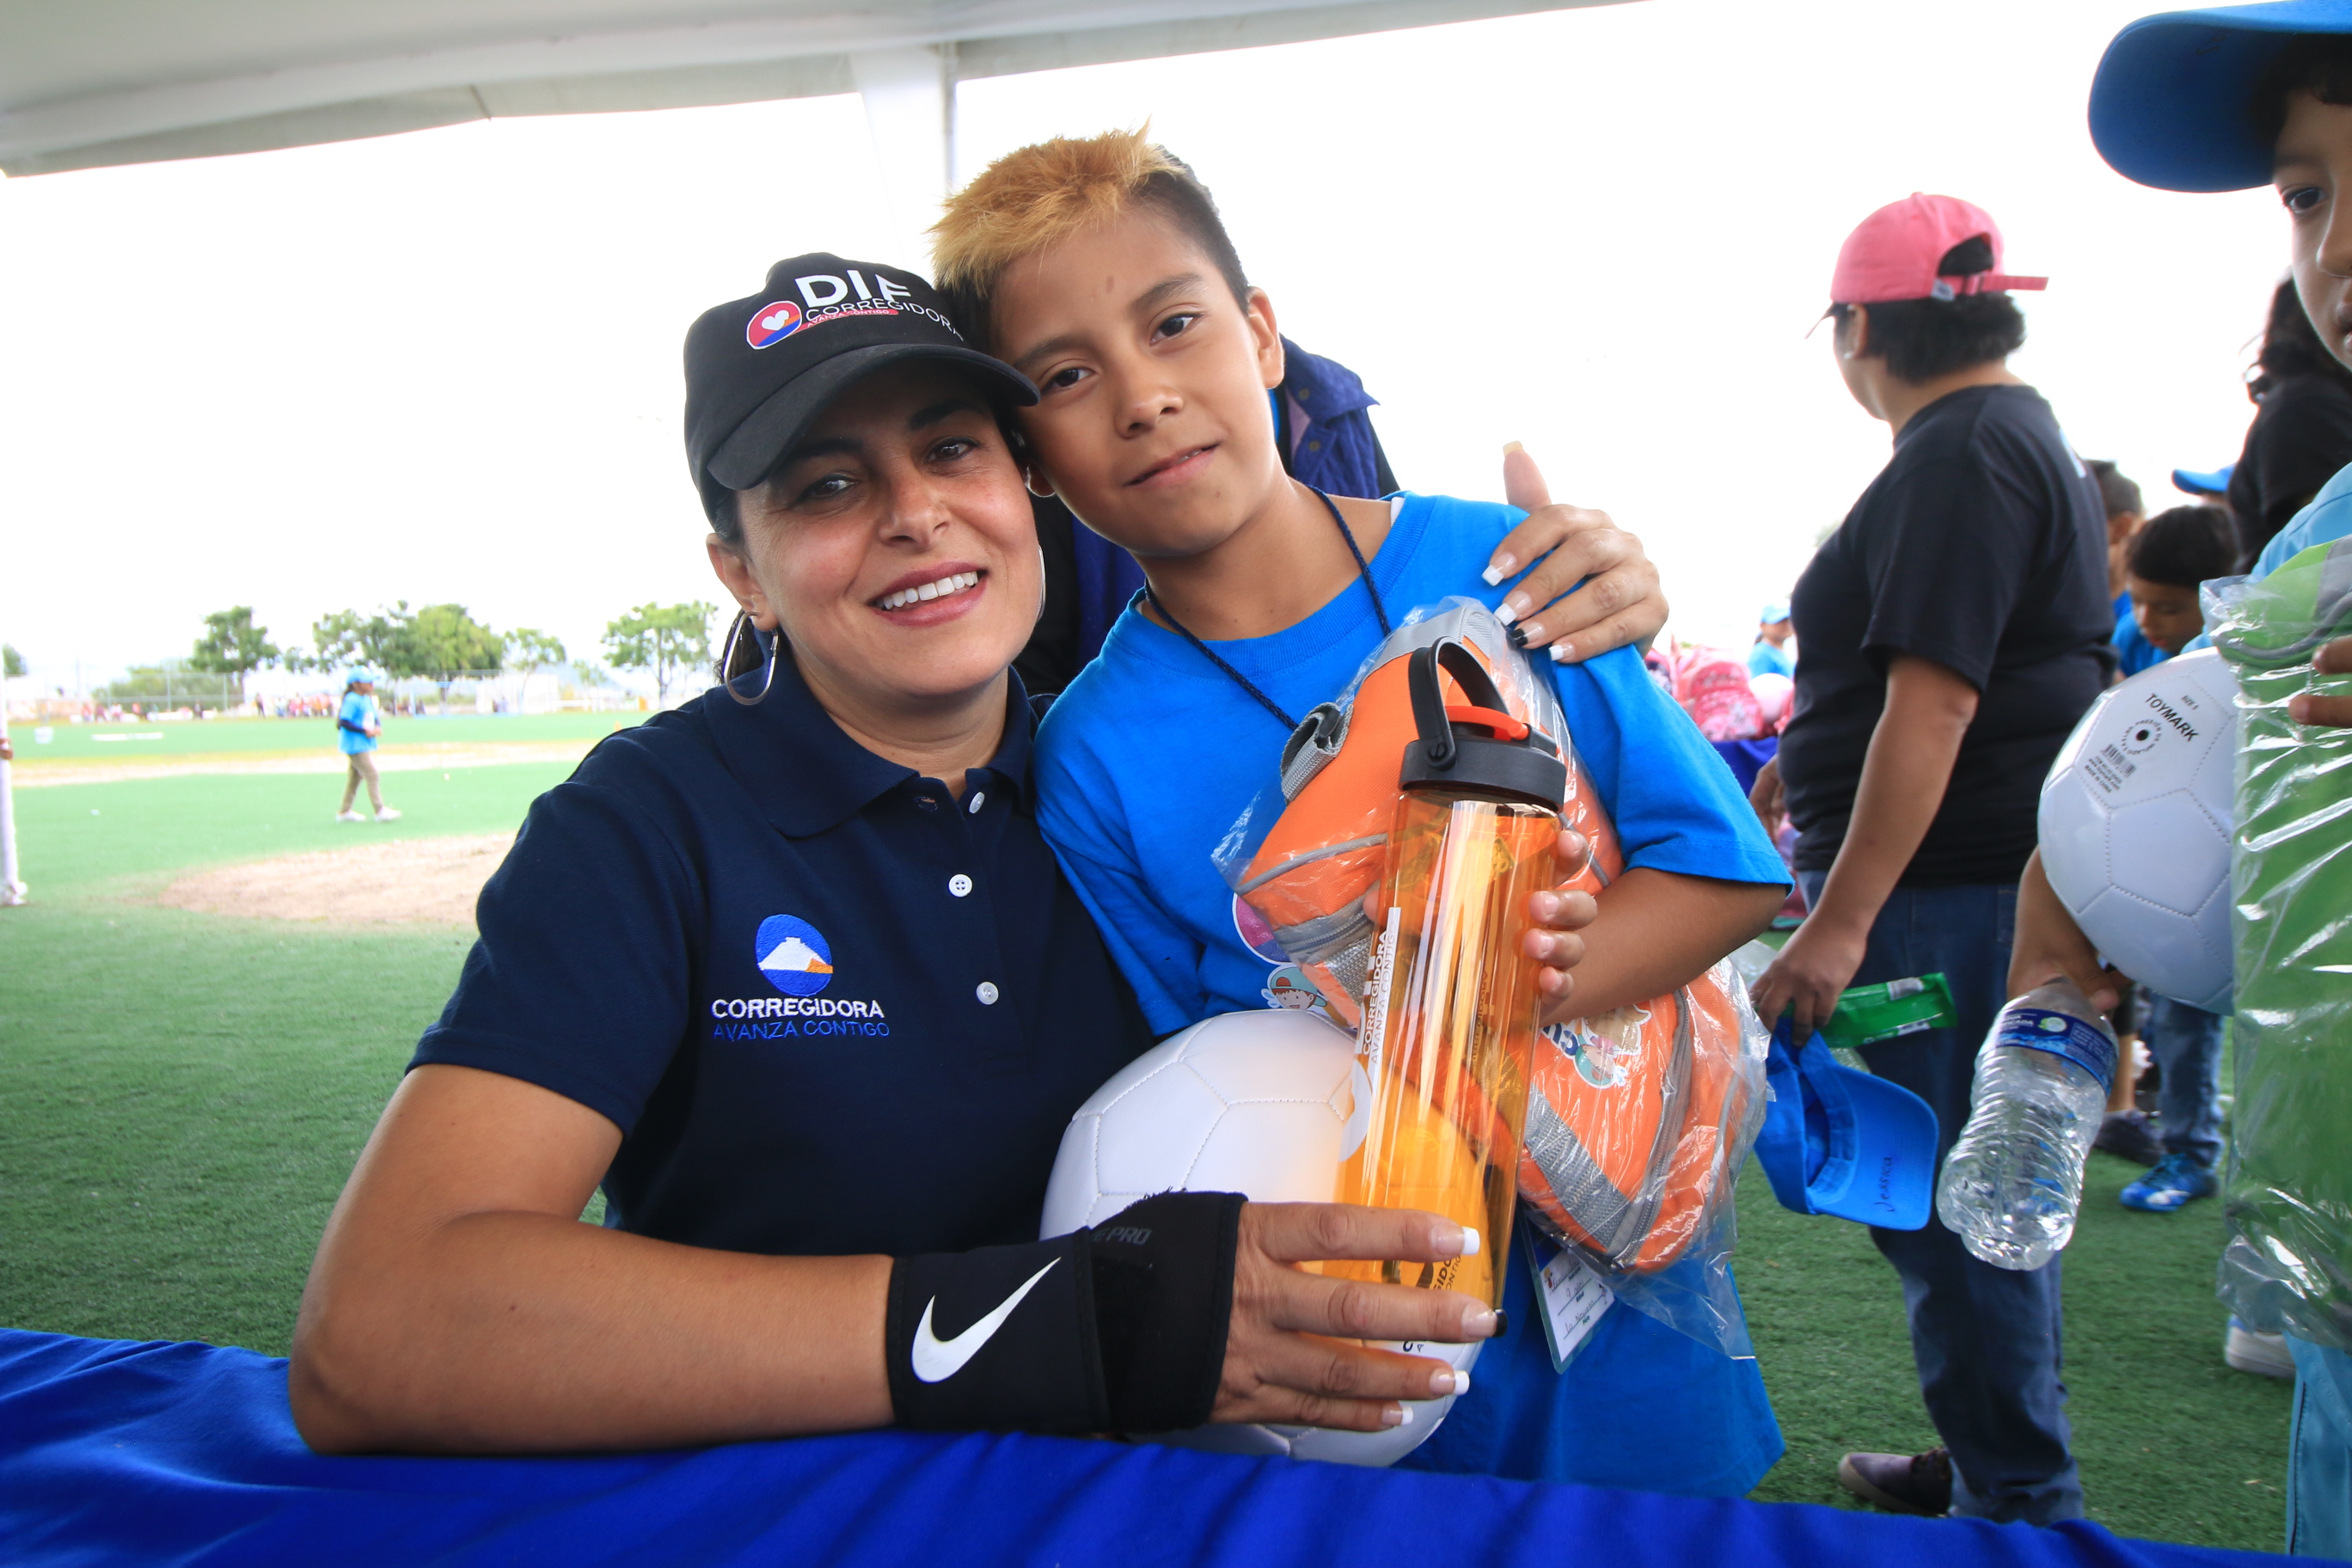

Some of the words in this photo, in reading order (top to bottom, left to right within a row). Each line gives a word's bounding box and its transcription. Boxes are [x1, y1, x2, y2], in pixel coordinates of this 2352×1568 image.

[794, 269, 912, 308] DIF
[807, 312, 845, 328] AVANZA
[2145, 693, 2200, 742] TOYMARK
[712, 997, 885, 1020] CORREGIDORA
[1363, 931, 1387, 1055] CORREGIDORA
[1370, 998, 1386, 1065] AVANZA
[1381, 922, 1396, 993] CONTIGO
[713, 1020, 799, 1042] AVANZA
[803, 1020, 891, 1037] CONTIGO
[1105, 1226, 1153, 1246] PRO
[1446, 1255, 1461, 1291] ONTIG
